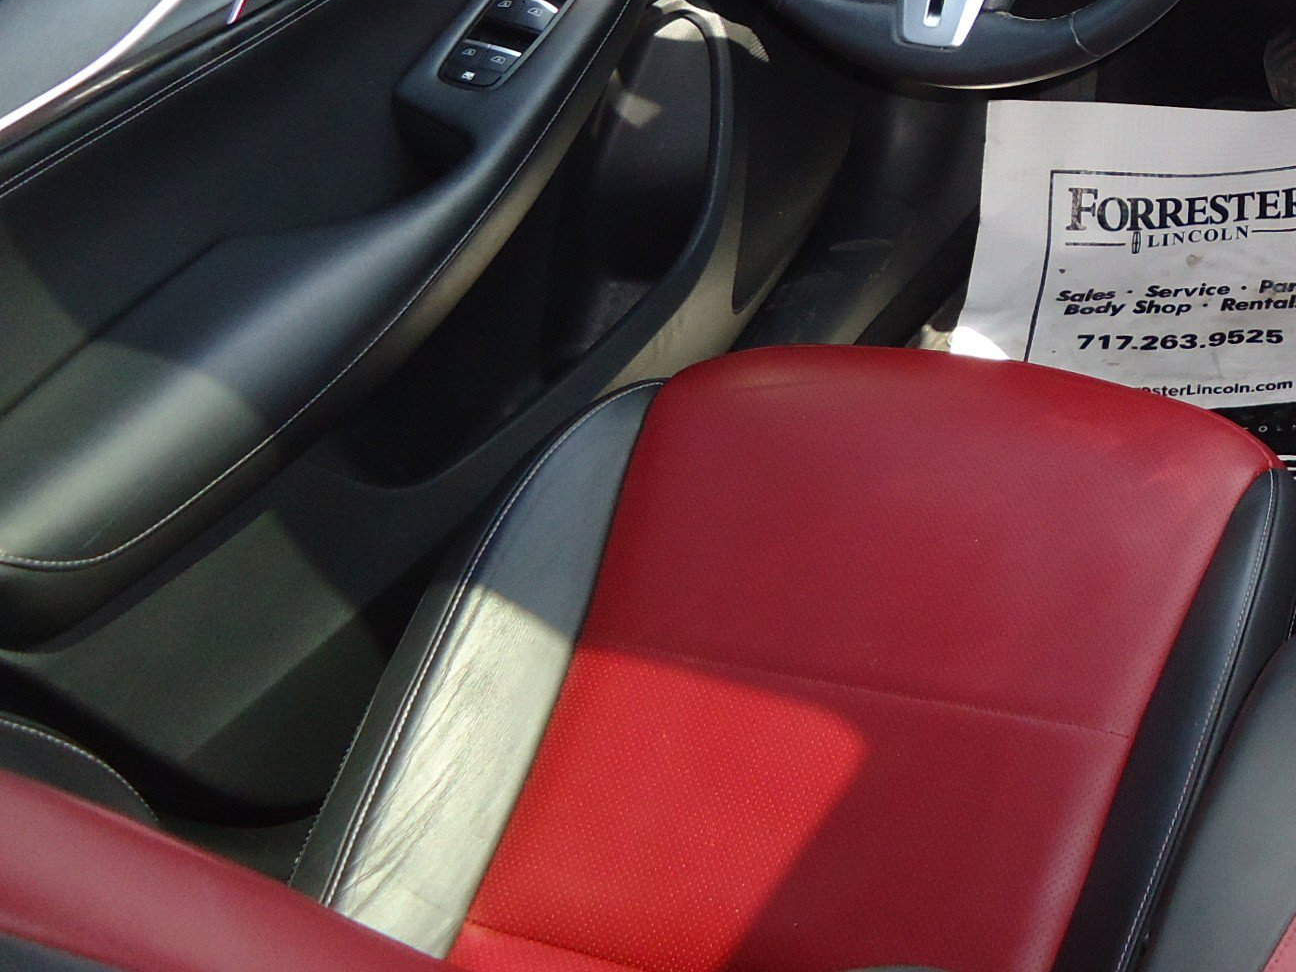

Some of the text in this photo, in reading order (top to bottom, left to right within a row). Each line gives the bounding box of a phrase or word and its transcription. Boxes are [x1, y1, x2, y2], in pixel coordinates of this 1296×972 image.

[1147, 224, 1251, 249] LINCOLN
[1055, 288, 1116, 304] Sales
[1144, 282, 1231, 299] Service
[1063, 300, 1124, 318] Body
[1132, 297, 1193, 318] Shop
[1076, 329, 1285, 351] 717.263.9525
[1139, 380, 1293, 397] esterLincoln.com
